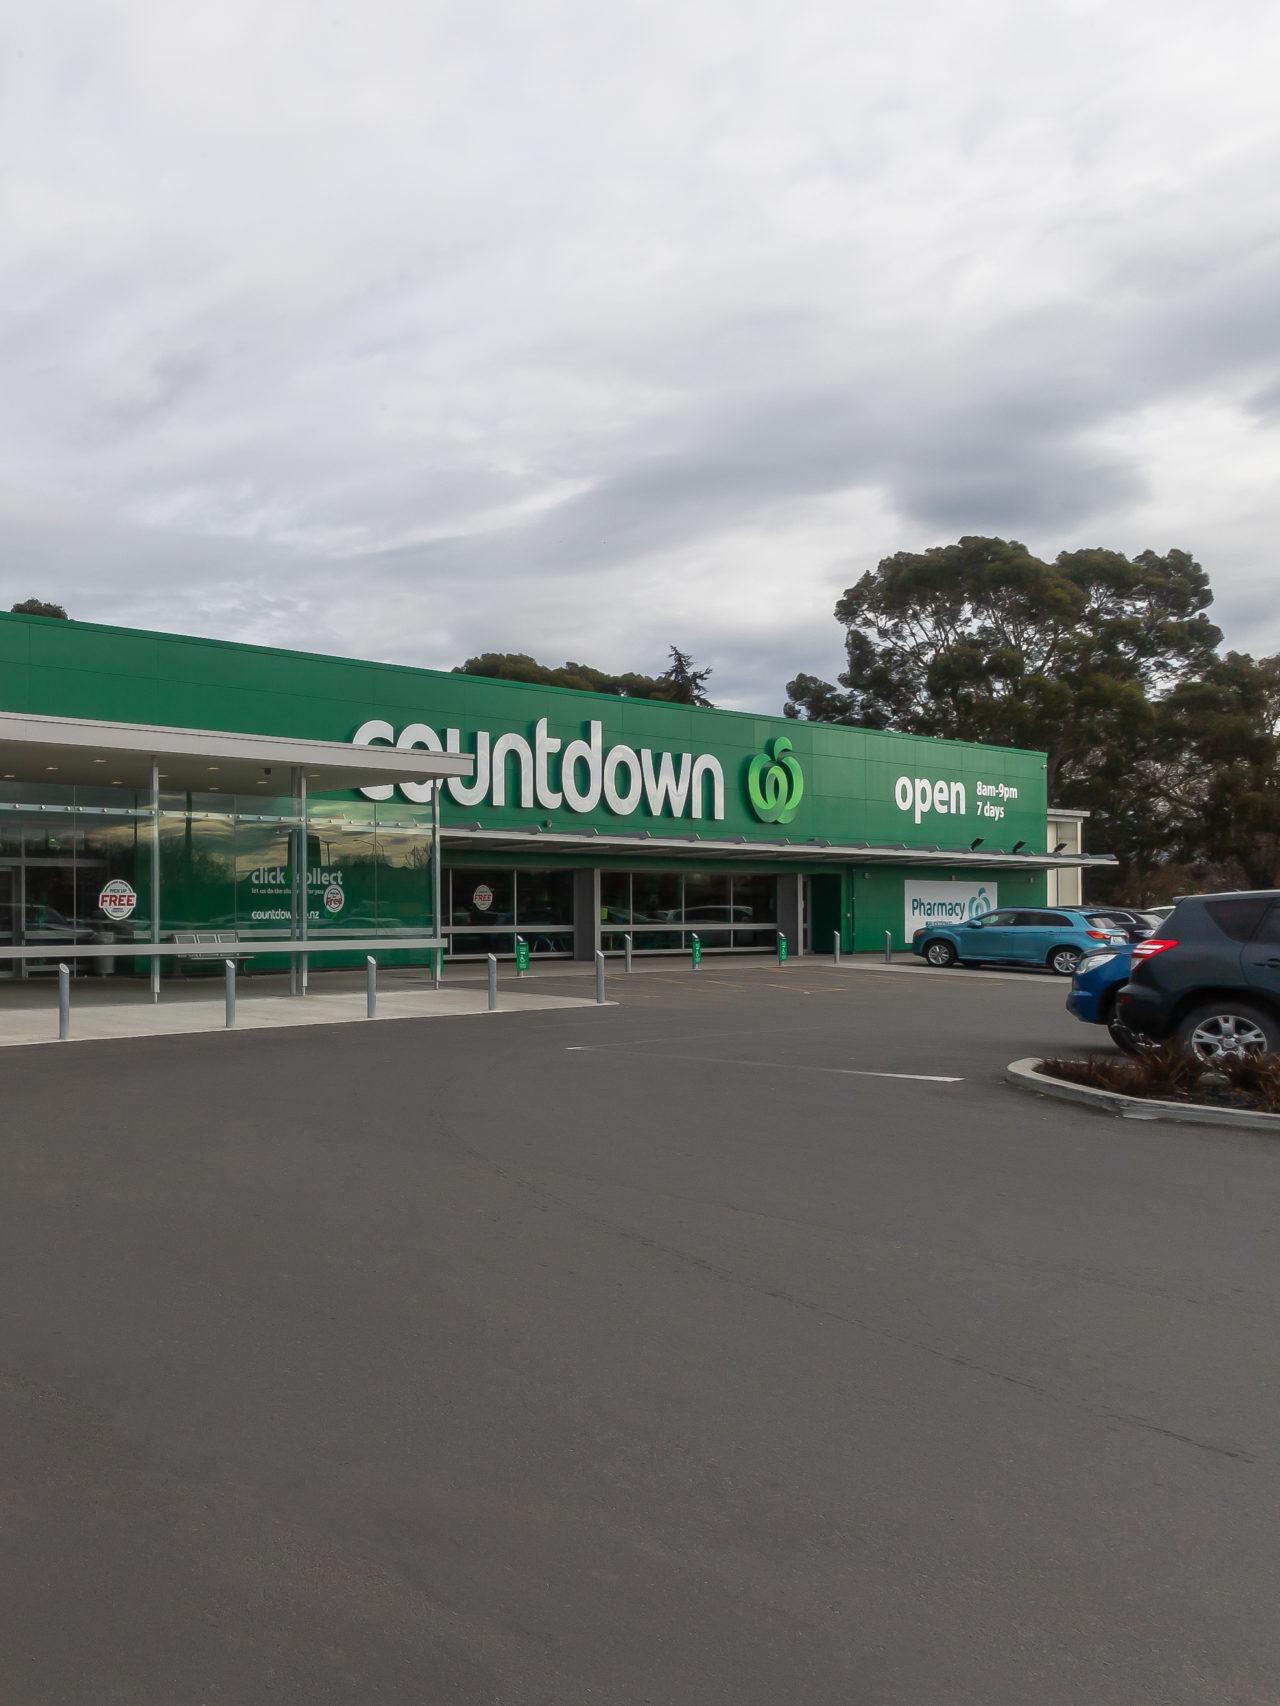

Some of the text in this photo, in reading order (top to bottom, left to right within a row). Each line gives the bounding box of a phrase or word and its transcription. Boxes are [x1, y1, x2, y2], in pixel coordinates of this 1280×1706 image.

[351, 718, 725, 820] countdown
[895, 776, 966, 824] open
[976, 781, 1018, 801] 8am-9pm
[976, 801, 1005, 821] 7 days
[251, 867, 286, 884] click
[100, 894, 136, 907] FREE
[912, 898, 965, 920] Pharmacy
[251, 908, 320, 920] countdow..nz
